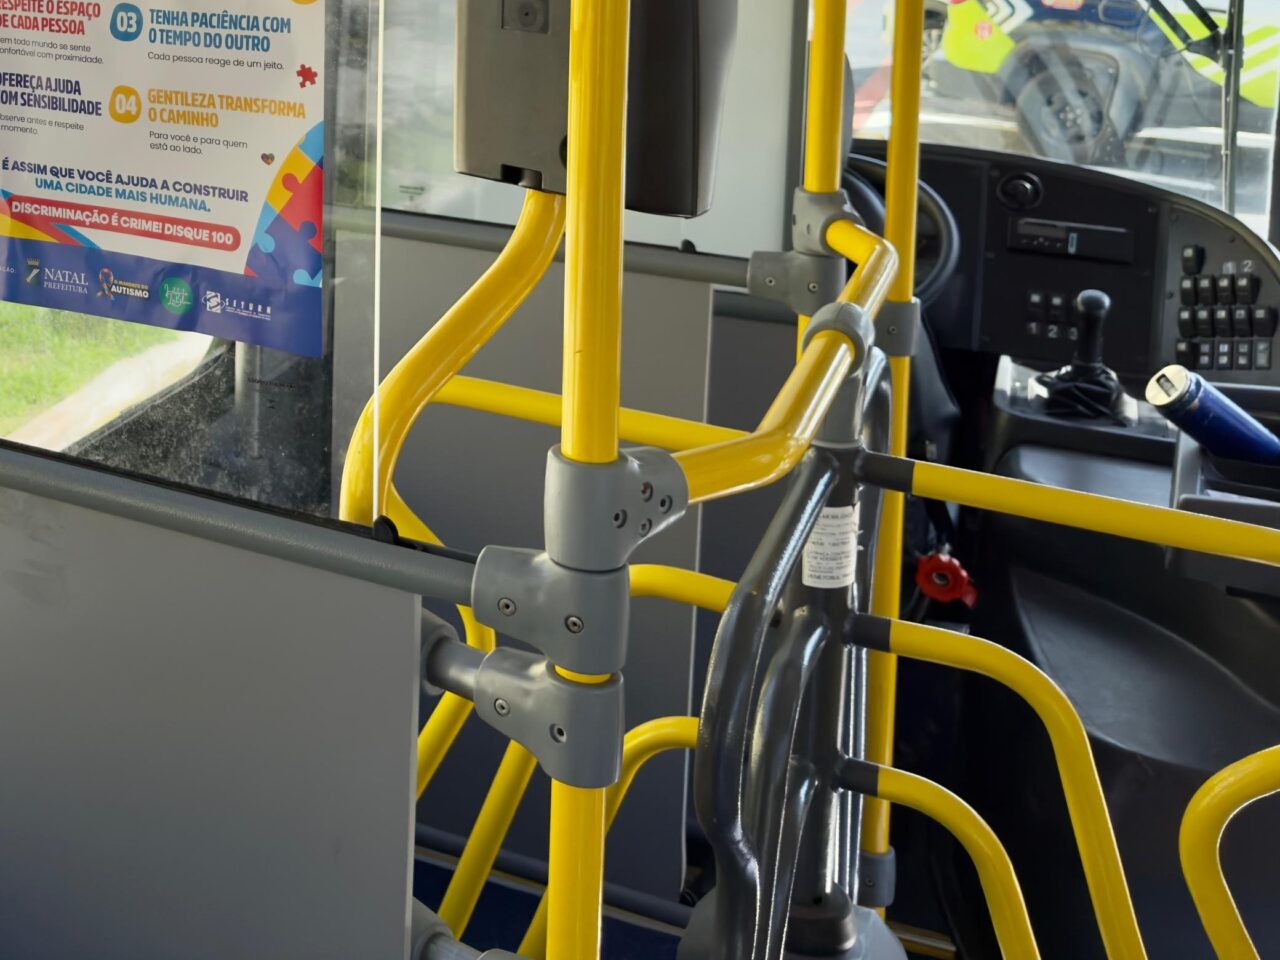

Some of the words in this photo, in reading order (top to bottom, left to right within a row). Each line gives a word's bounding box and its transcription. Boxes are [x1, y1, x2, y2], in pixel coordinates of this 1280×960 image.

[46, 0, 54, 14] O
[56, 0, 101, 21] ESPAÇO
[10, 15, 40, 31] CADA
[41, 17, 86, 35] PESSOA
[116, 11, 138, 33] 03
[149, 8, 189, 27] TENHA
[190, 10, 260, 32] PACIÊNCIA
[262, 16, 291, 34] COM
[14, 38, 31, 46] todo
[32, 40, 58, 49] mundo
[70, 44, 91, 52] sente
[148, 28, 157, 44] O
[158, 29, 201, 47] TEMPO
[203, 33, 223, 49] DO
[224, 35, 271, 53] OUTRO
[36, 50, 54, 59] com
[55, 53, 104, 65] proximidade.
[148, 52, 171, 61] Cada
[172, 54, 204, 65] pessoa
[205, 57, 231, 68] reage
[233, 58, 245, 67] de
[263, 61, 284, 71] jeito.
[45, 77, 81, 95] AJUDA
[20, 92, 102, 116] SENSIBILIDADE
[115, 93, 137, 116] 04
[147, 88, 216, 109] GENTILEZA
[218, 95, 306, 119] TRANSFORMA
[26, 117, 47, 126] antes
[54, 122, 85, 131] respeite
[148, 107, 157, 122] O
[159, 109, 219, 128] CAMINHO
[149, 130, 169, 140] Para
[170, 134, 191, 142] você
[200, 137, 221, 146] para
[222, 139, 248, 149] quem
[149, 141, 168, 151] está
[182, 145, 203, 155] lado.
[2, 157, 10, 170] É
[11, 160, 48, 176] ASSIM
[49, 166, 75, 179] QUE
[77, 168, 113, 184] VOCÊ
[115, 174, 158, 190] AJUDA
[160, 179, 170, 191] A
[172, 181, 249, 202] CONSTRUIR
[35, 178, 63, 191] UMA
[65, 182, 113, 197] CIDADE
[115, 188, 148, 202] MAIS
[149, 193, 211, 212] HUMANA.
[11, 200, 109, 226] DISCRIMINAÇÃO
[111, 212, 119, 226] É
[164, 223, 210, 241] DISQUE
[211, 231, 234, 245] 100
[44, 267, 88, 285] NATAL
[43, 281, 88, 294] PREFEITURA
[110, 284, 149, 298] AUTISMO
[1048, 325, 1058, 338] 2
